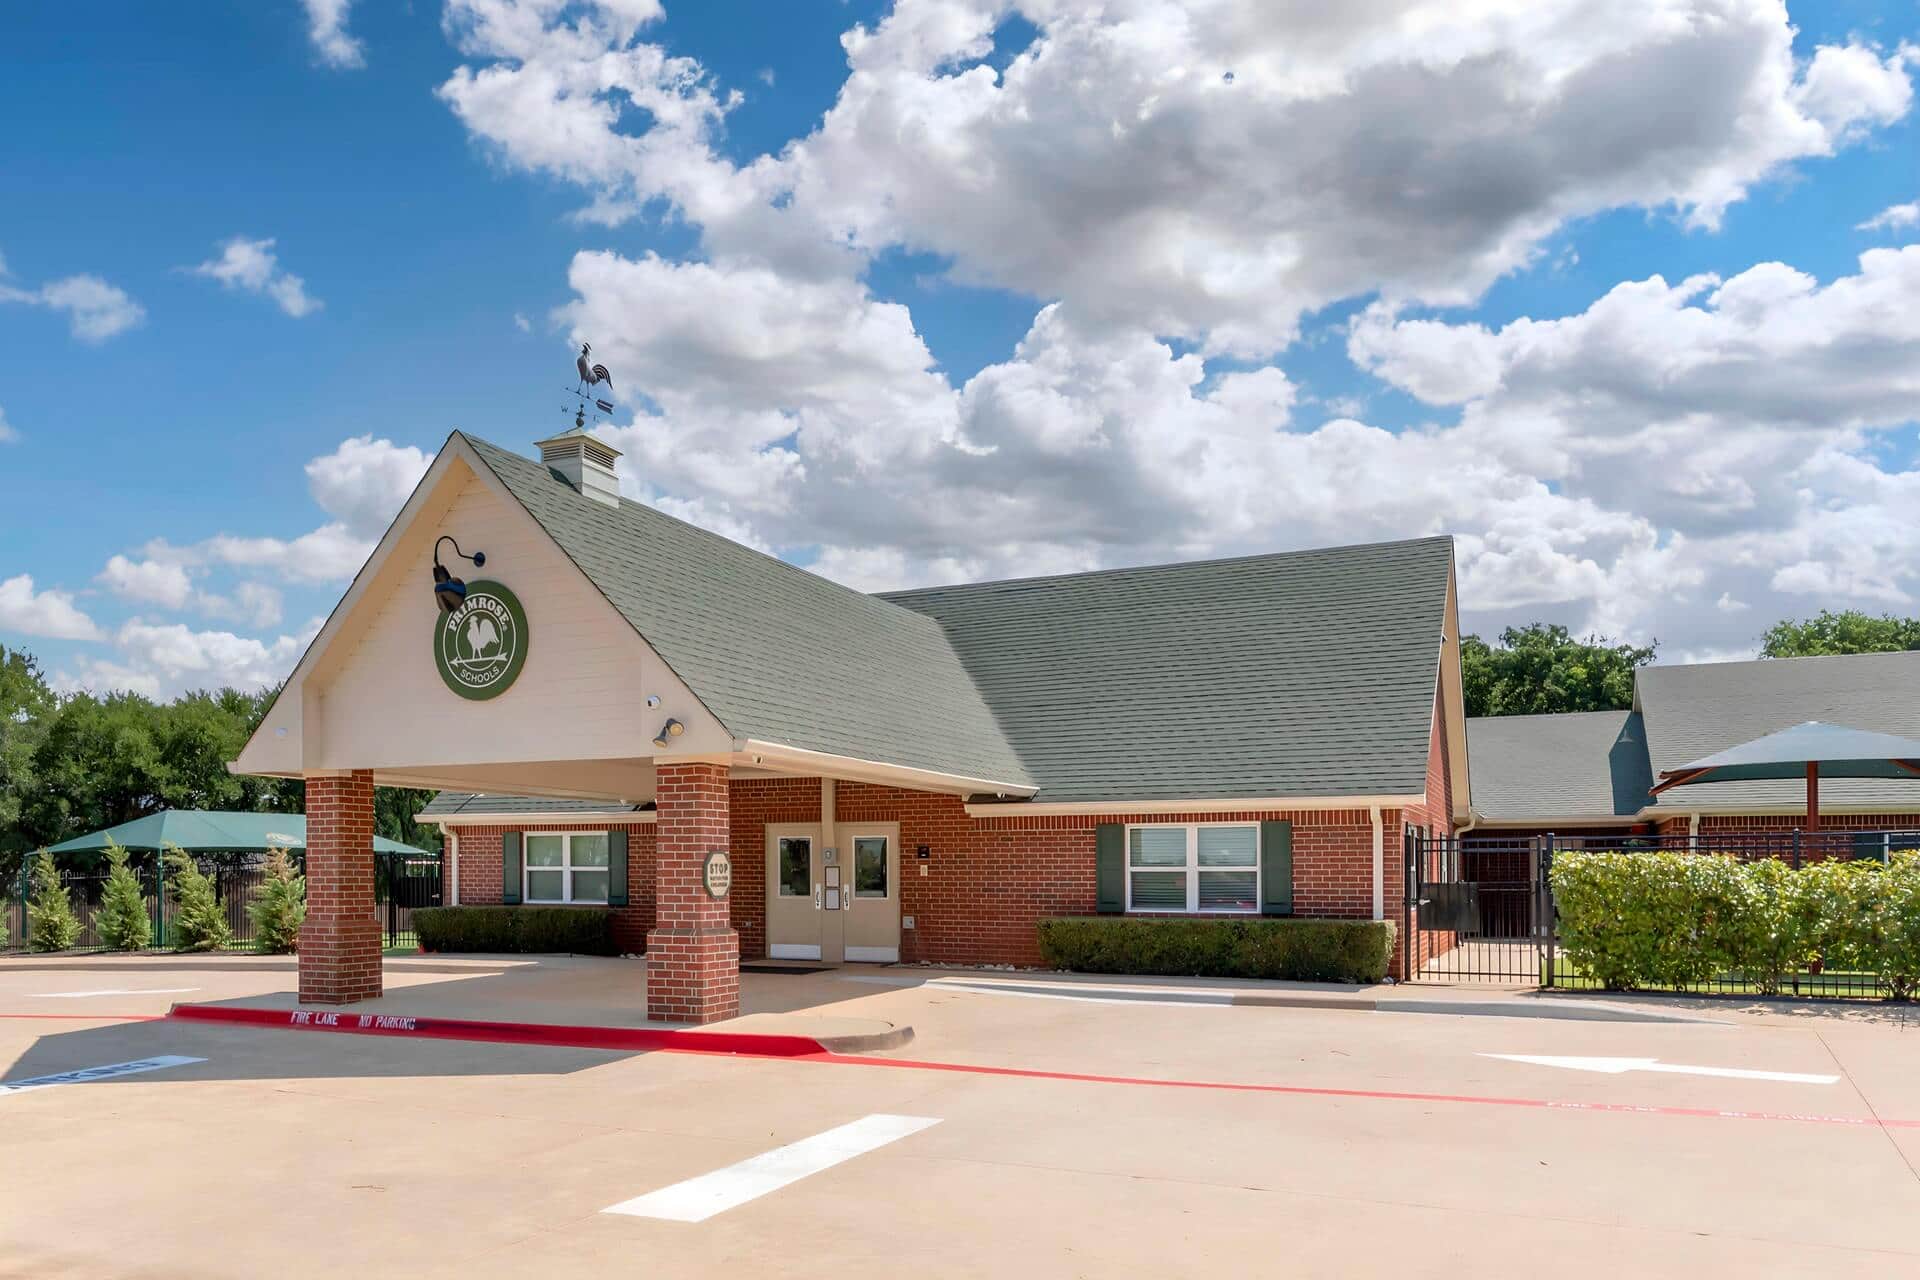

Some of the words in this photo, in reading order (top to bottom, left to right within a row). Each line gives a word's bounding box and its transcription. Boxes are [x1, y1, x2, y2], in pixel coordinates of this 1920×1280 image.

[448, 596, 509, 632] PRIMROSE
[460, 666, 500, 683] SCHOOLS
[709, 863, 728, 874] STOP
[290, 1011, 312, 1024] FIRE
[315, 1012, 340, 1025] LANE
[358, 1015, 372, 1028] NO
[375, 1015, 416, 1030] PARKING
